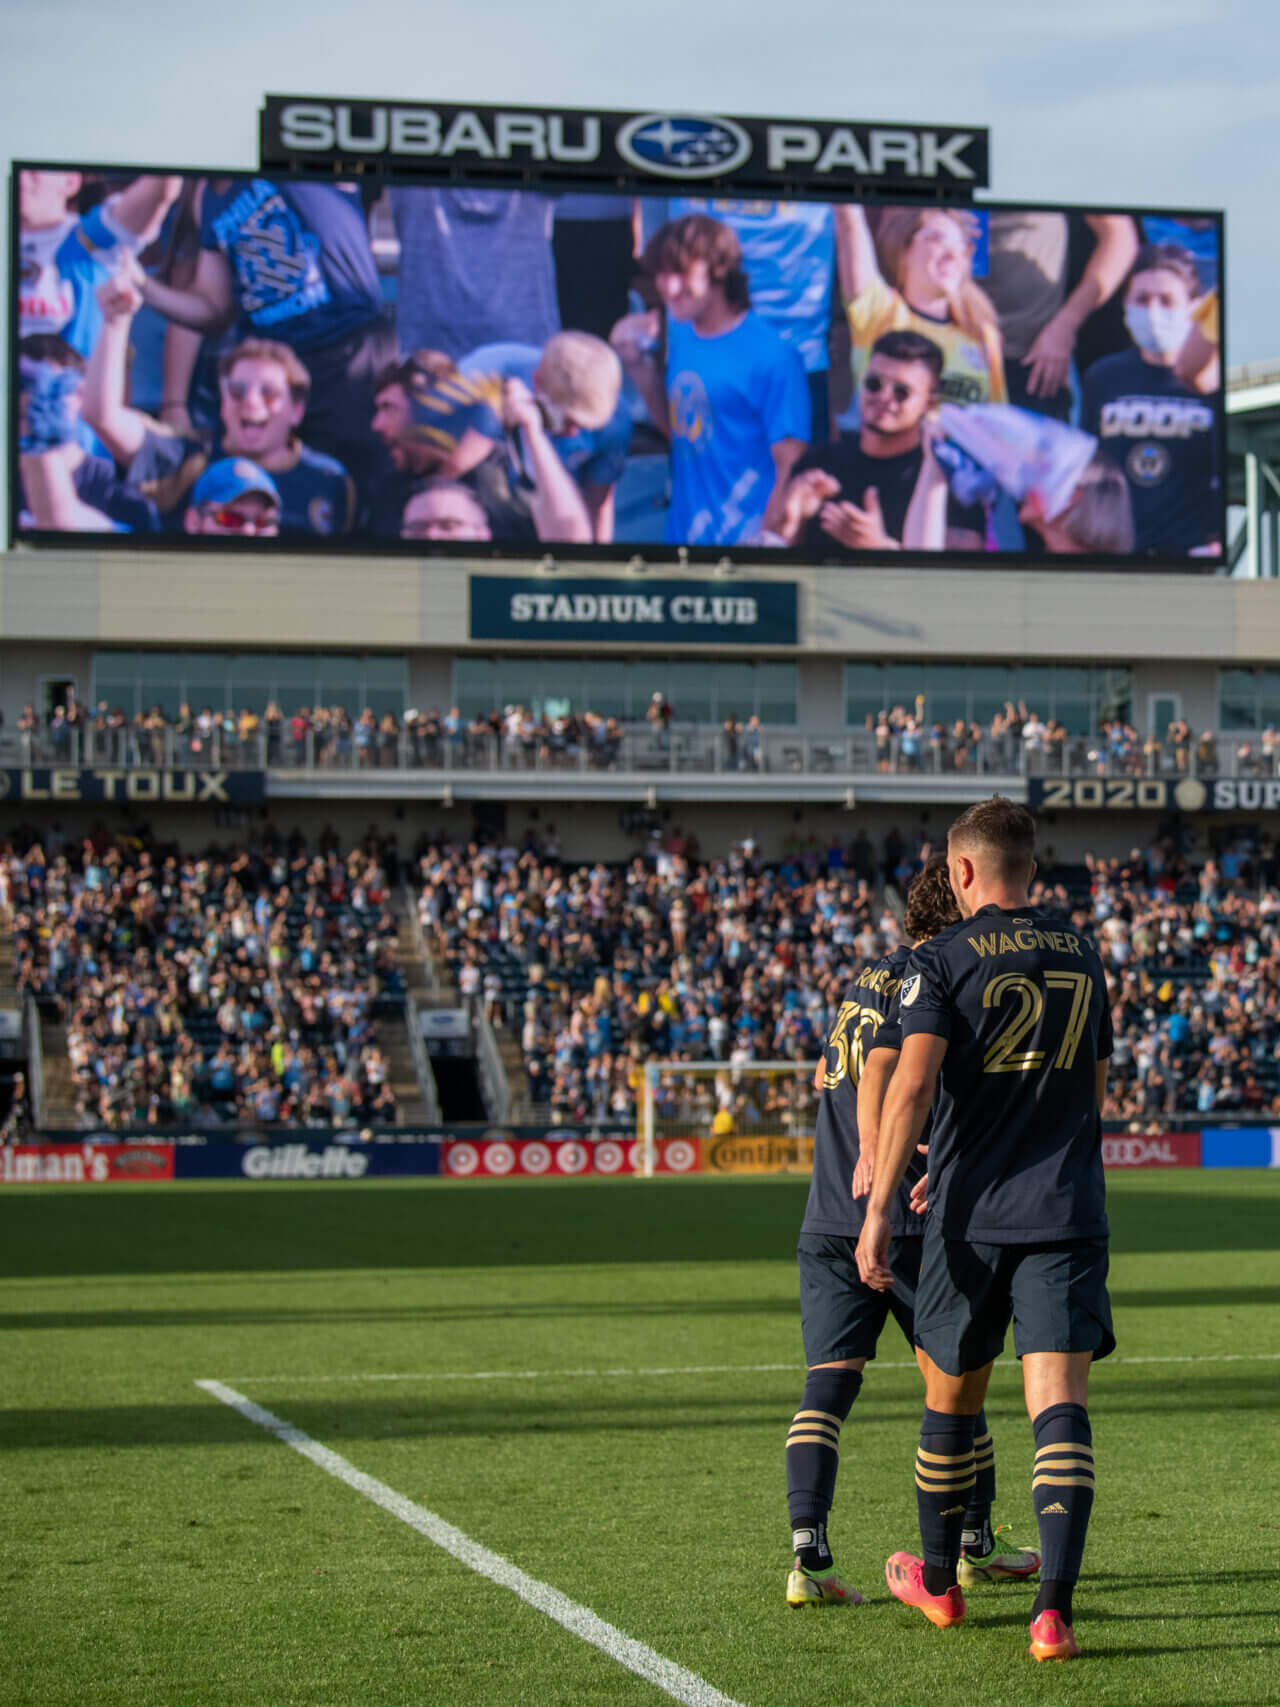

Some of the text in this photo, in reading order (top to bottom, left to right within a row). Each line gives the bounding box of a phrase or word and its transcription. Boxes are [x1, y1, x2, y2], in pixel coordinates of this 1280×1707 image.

[281, 104, 976, 179] SUBARU PARK
[510, 593, 757, 624] STADIUM CLUB
[22, 769, 230, 801] LE TOUX
[1041, 779, 1166, 809] 2020
[967, 929, 1084, 957] WAGNER
[982, 970, 1093, 1073] 27
[0, 1143, 109, 1183] lman's
[242, 1144, 368, 1178] Gillette
[709, 1137, 815, 1171] Contin
